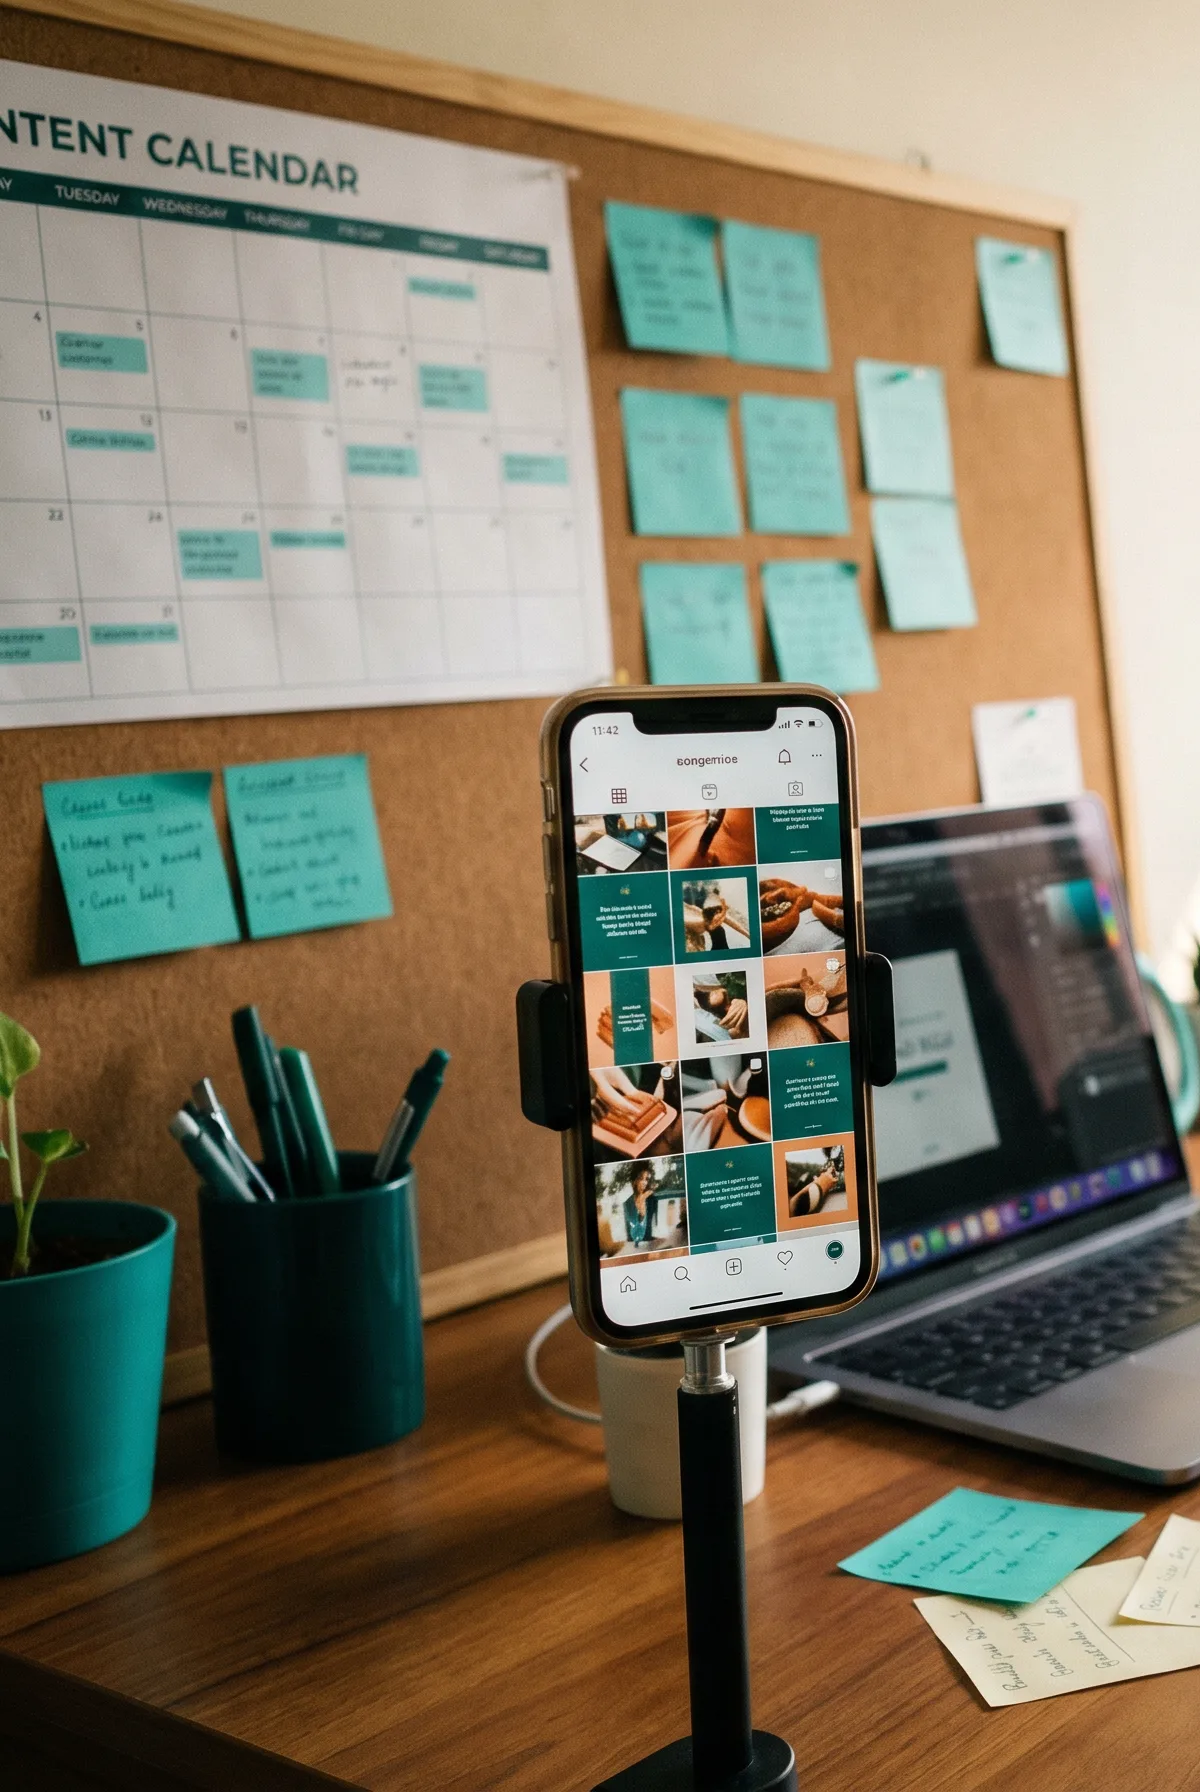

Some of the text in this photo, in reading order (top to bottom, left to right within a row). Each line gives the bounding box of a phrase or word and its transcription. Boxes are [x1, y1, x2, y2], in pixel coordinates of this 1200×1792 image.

[146, 132, 361, 195] CALENDAR
[54, 184, 121, 206] TUESDAY
[592, 725, 619, 736] 11:42
